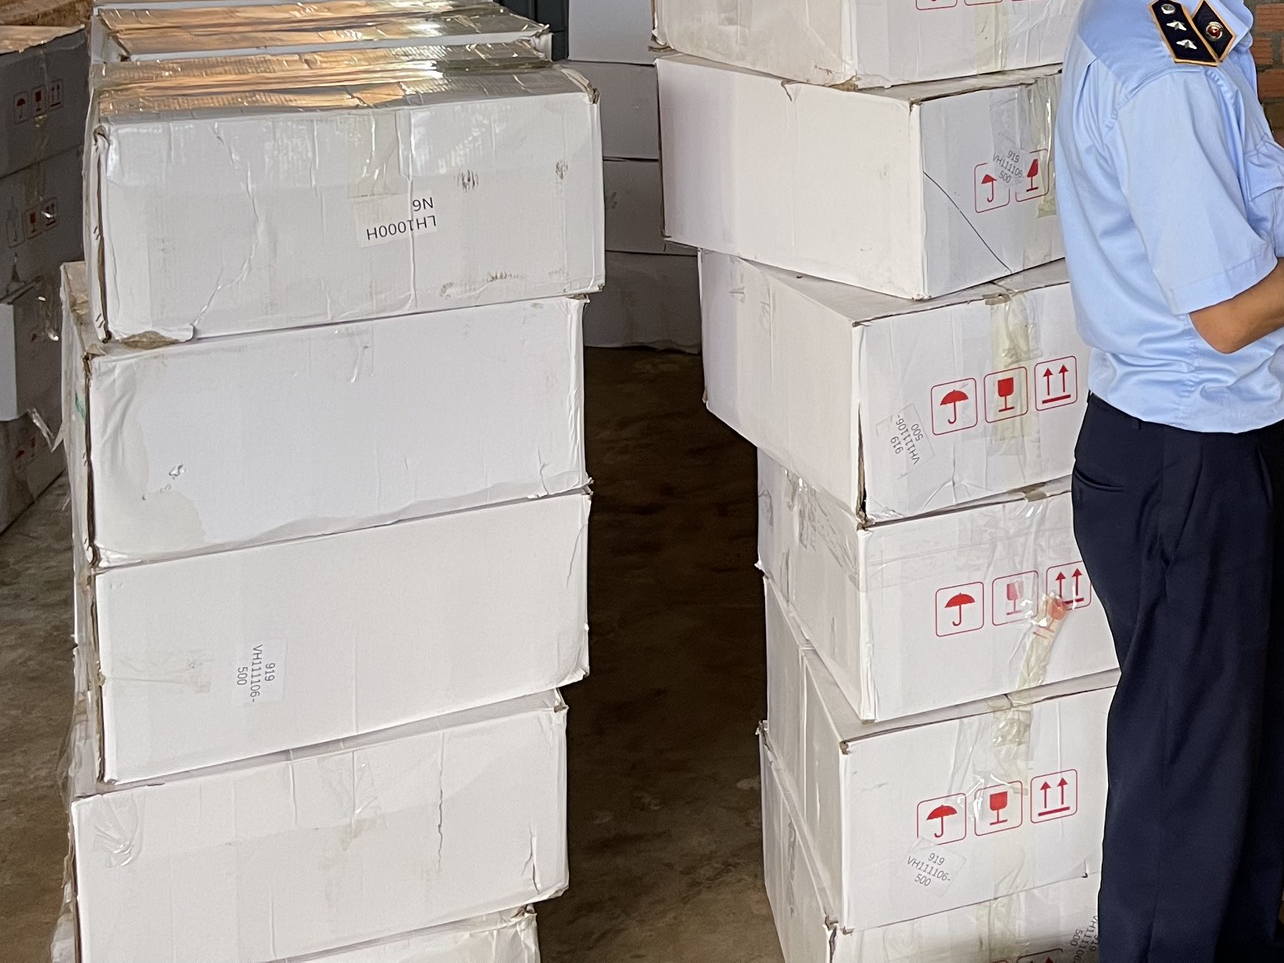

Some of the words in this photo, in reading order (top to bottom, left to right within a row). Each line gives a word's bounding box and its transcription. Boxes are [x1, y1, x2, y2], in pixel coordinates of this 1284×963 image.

[412, 197, 434, 212] N6
[366, 215, 437, 240] LH1000H
[910, 423, 924, 442] 500
[890, 436, 904, 454] 919
[236, 666, 249, 686] 500
[264, 662, 276, 682] 919
[928, 852, 945, 866] 919
[914, 873, 932, 887] 500
[1069, 928, 1084, 947] 500
